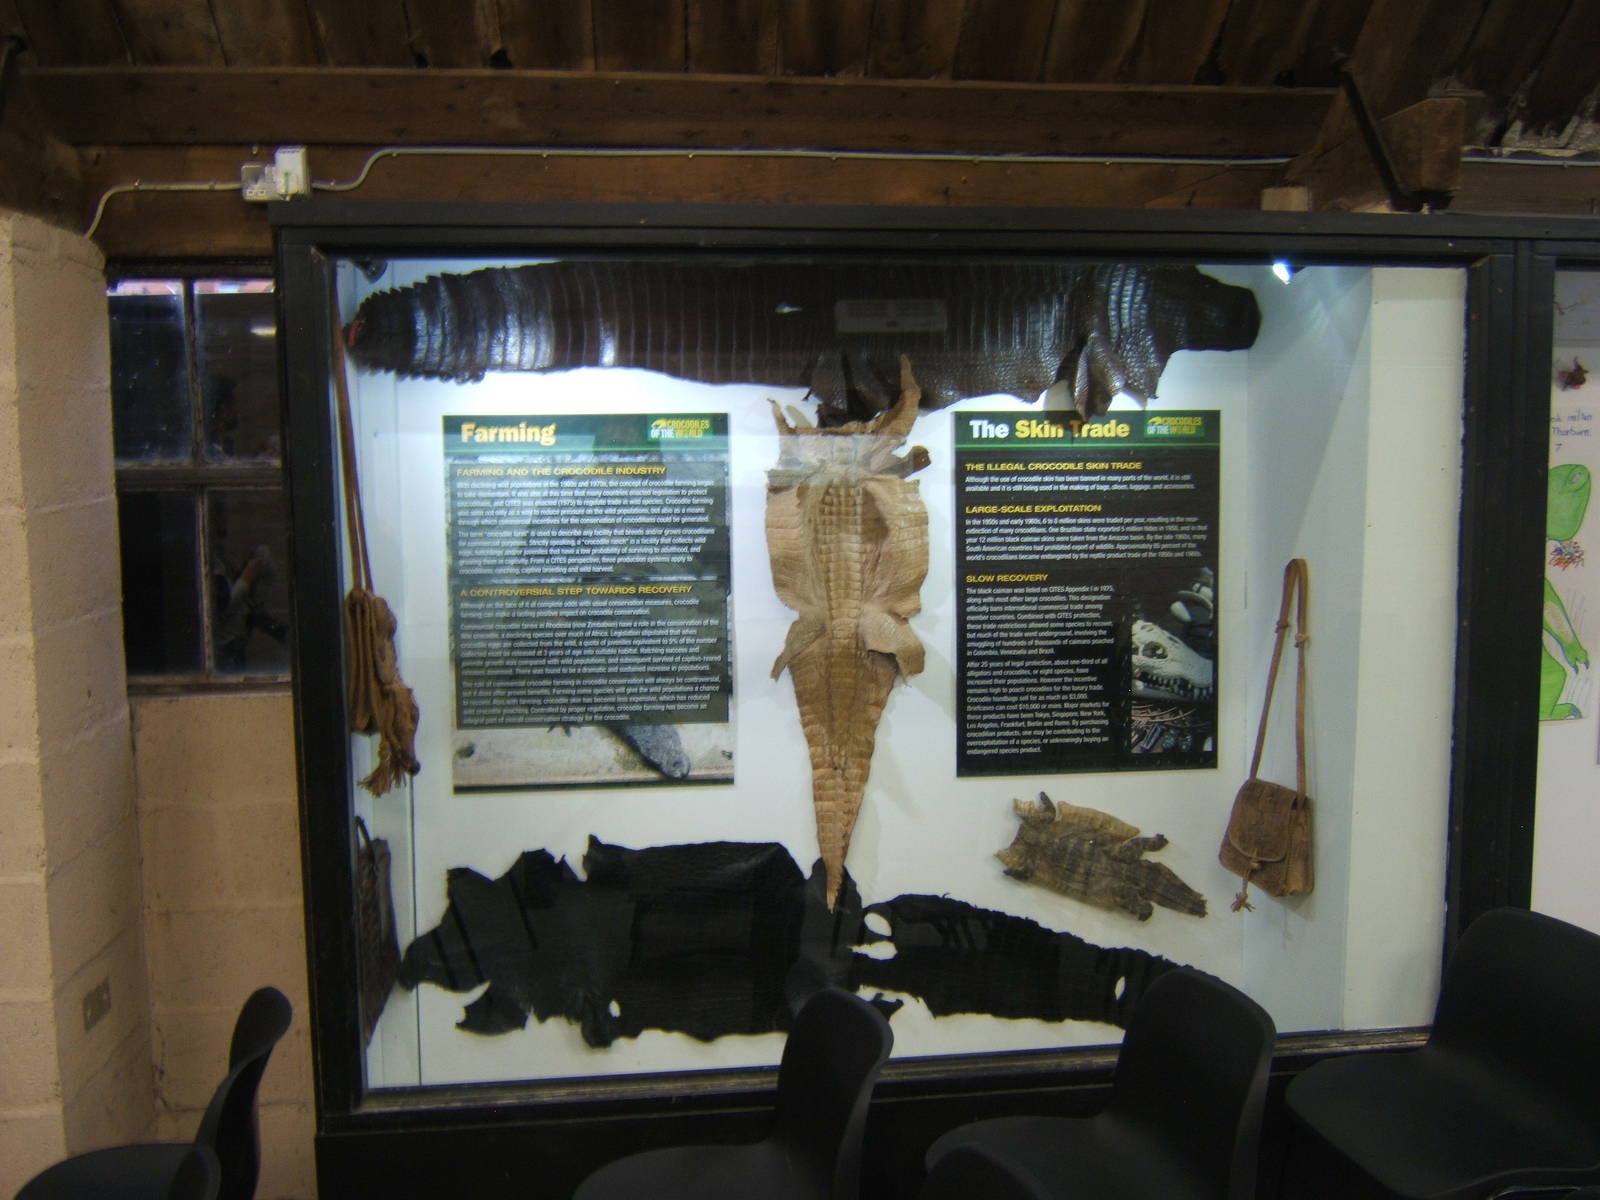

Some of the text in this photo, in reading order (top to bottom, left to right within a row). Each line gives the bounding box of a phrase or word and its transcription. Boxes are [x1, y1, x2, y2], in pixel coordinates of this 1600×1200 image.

[650, 428, 660, 438] OF
[661, 428, 674, 438] THE
[969, 420, 1009, 438] The
[1015, 419, 1064, 438] Skin
[461, 422, 556, 446] Farming
[456, 468, 504, 476] FARMING
[553, 467, 613, 475] CROCODILE
[616, 466, 666, 475] INDUSTRY
[1034, 504, 1102, 512] EXPLOITATION
[996, 574, 1048, 582] RECOVERY
[469, 588, 554, 596] CONTROVERSIAL
[557, 586, 582, 595] STEP
[586, 586, 636, 595] TOWARDS
[638, 584, 693, 594] RECOVERY
